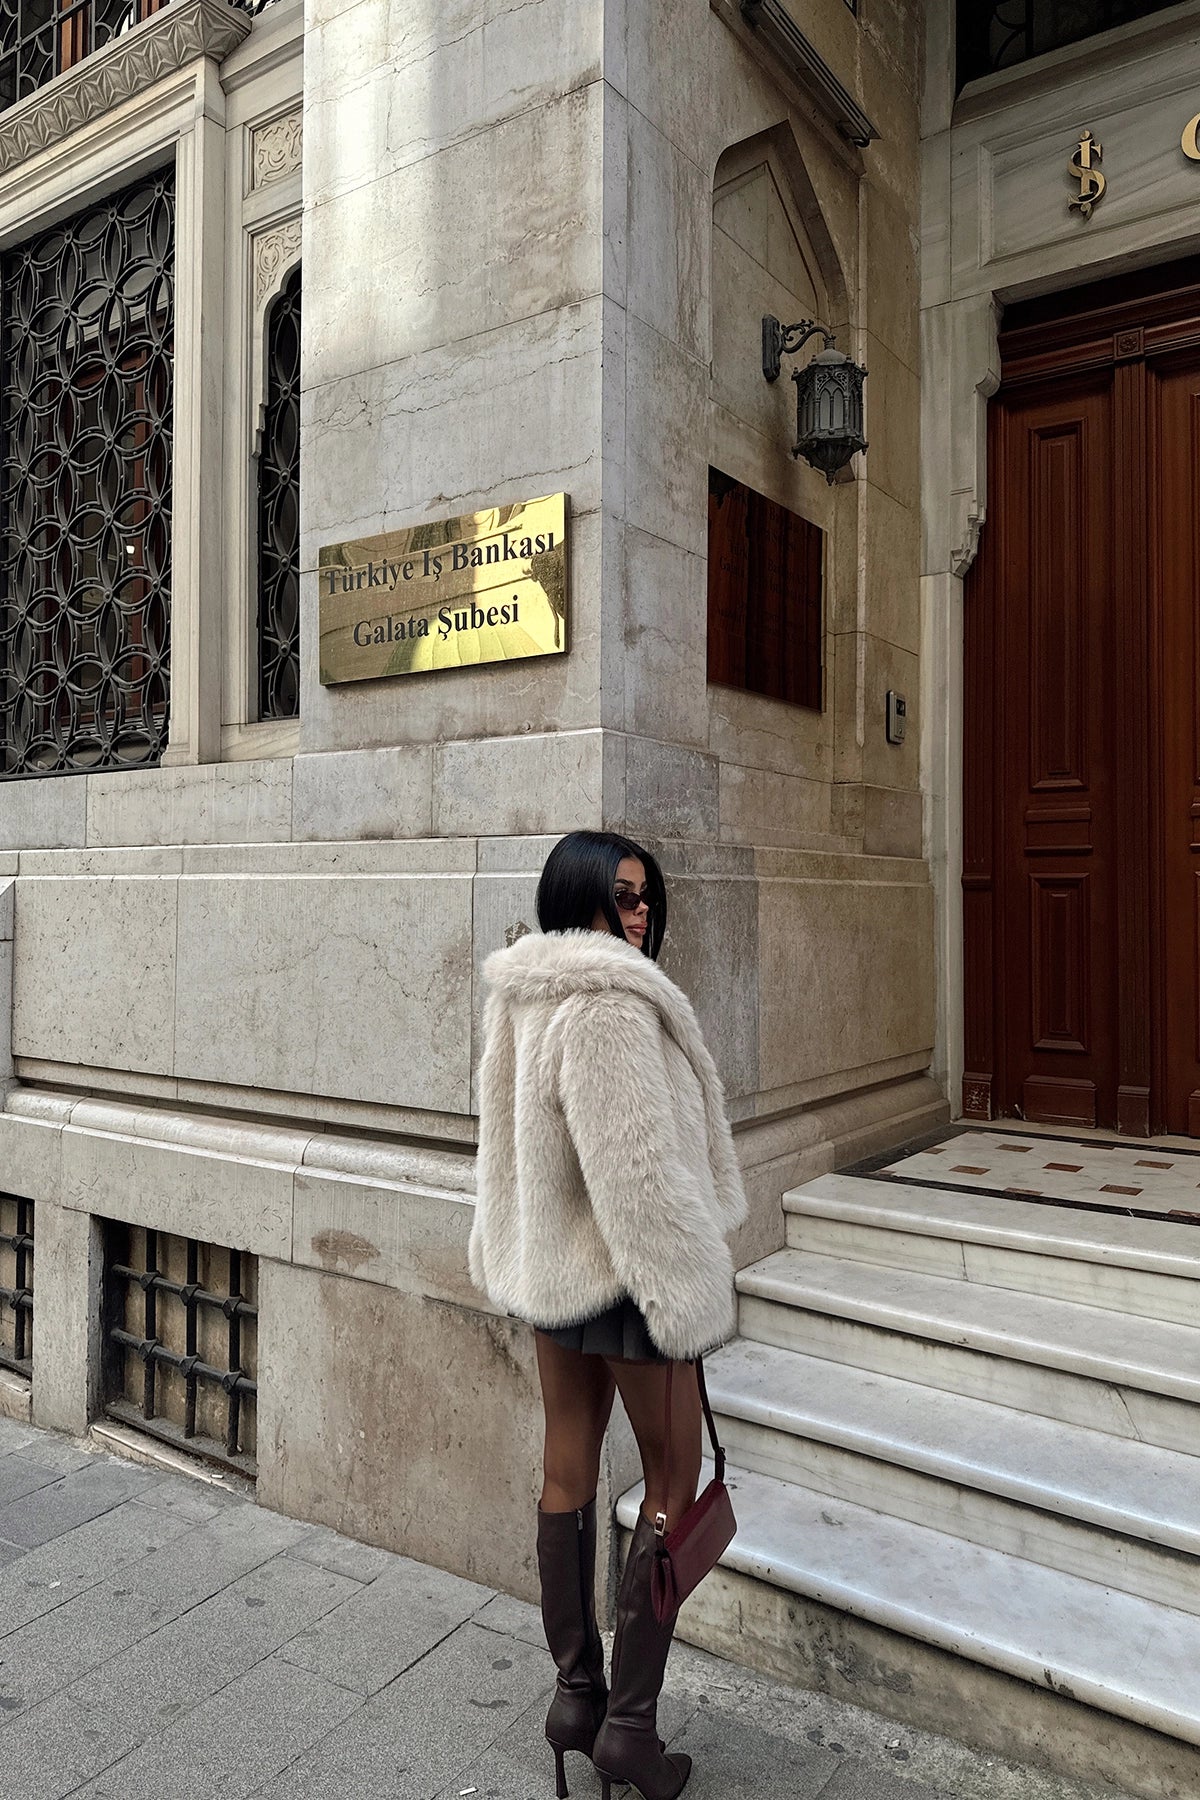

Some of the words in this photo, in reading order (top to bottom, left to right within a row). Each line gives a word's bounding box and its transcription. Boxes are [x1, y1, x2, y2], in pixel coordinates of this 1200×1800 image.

[324, 558, 414, 596] Türkiye
[450, 532, 555, 572] Bankası
[353, 615, 430, 647] Galata
[438, 594, 519, 641] Şubesi
